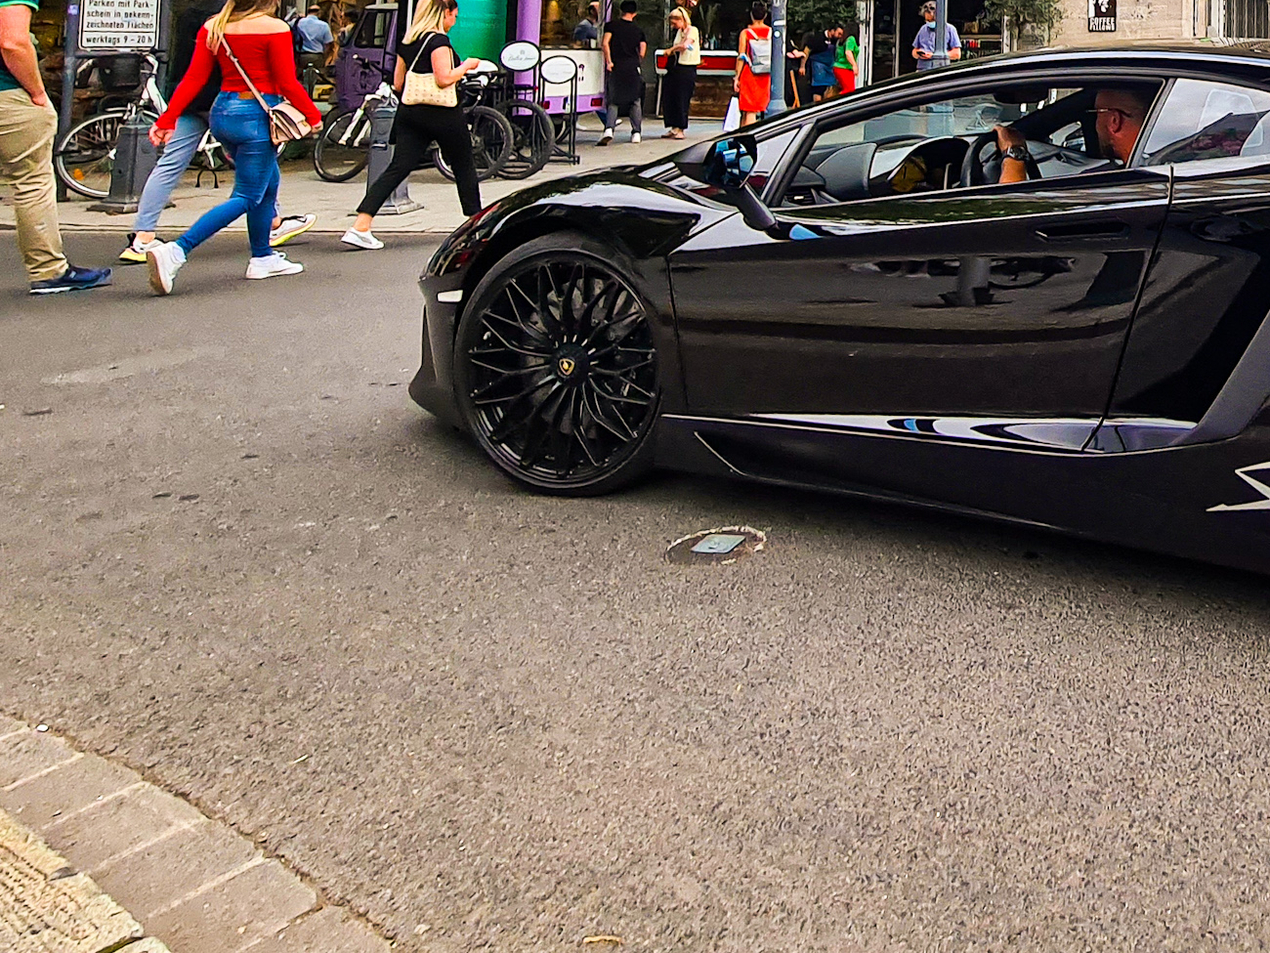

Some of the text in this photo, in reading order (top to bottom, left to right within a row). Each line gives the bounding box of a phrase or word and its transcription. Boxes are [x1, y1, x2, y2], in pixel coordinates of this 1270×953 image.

[117, 0, 131, 8] mit
[133, 0, 154, 9] Park-
[86, 9, 111, 18] schein
[114, 10, 122, 18] in
[86, 21, 125, 29] zeichneten
[85, 35, 121, 46] werktags
